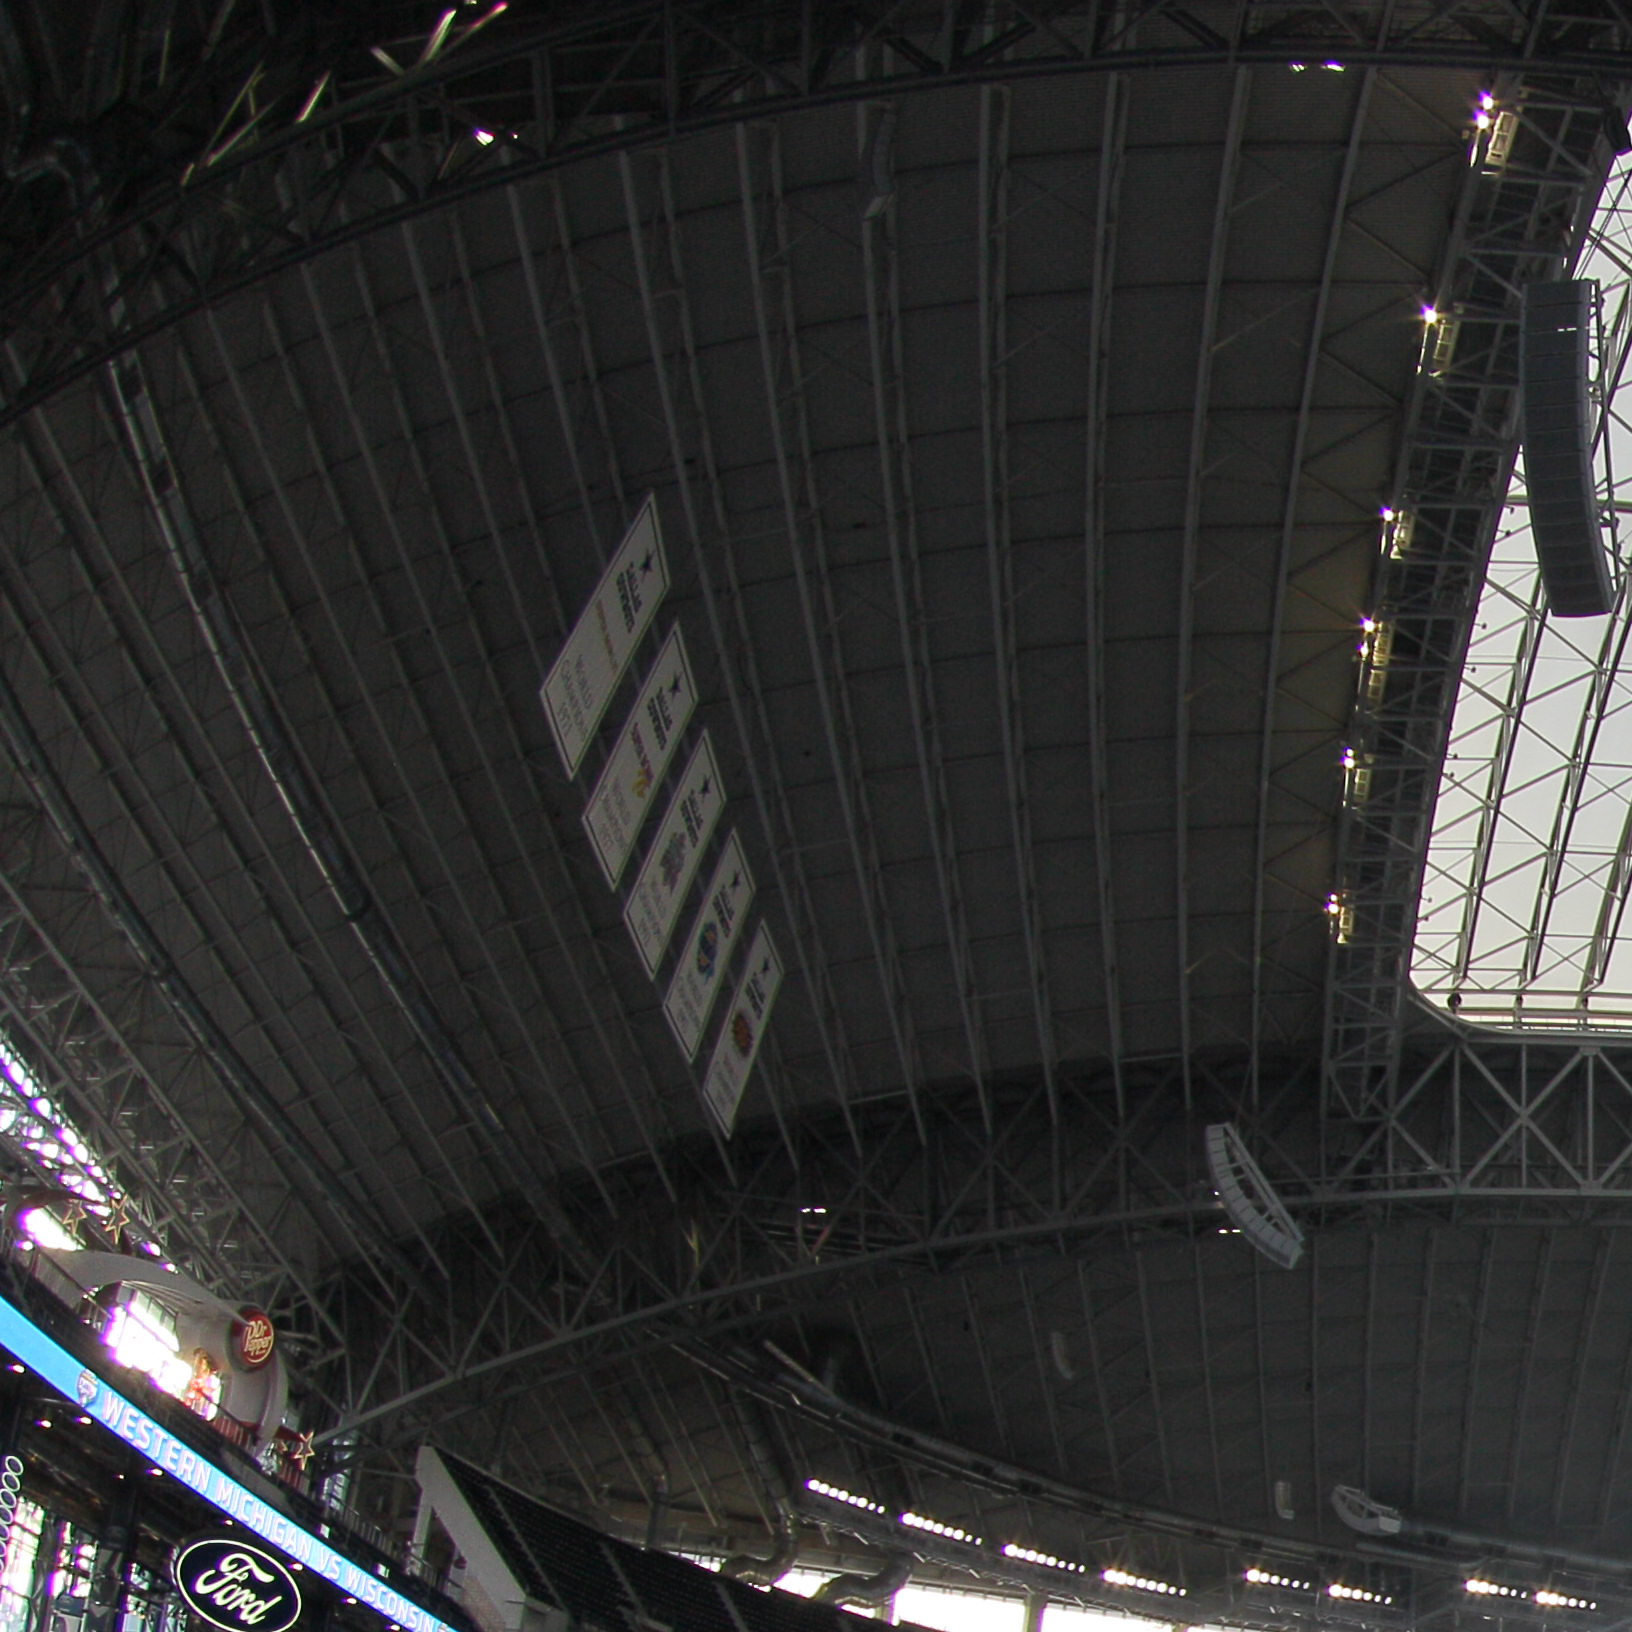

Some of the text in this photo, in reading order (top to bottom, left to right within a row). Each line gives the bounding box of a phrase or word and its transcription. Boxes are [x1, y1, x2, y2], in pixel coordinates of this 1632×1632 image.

[102, 1391, 210, 1490] WESTERN
[216, 1479, 312, 1560] MICHIGAN
[318, 1548, 342, 1580] VS
[193, 1552, 284, 1626] Ford
